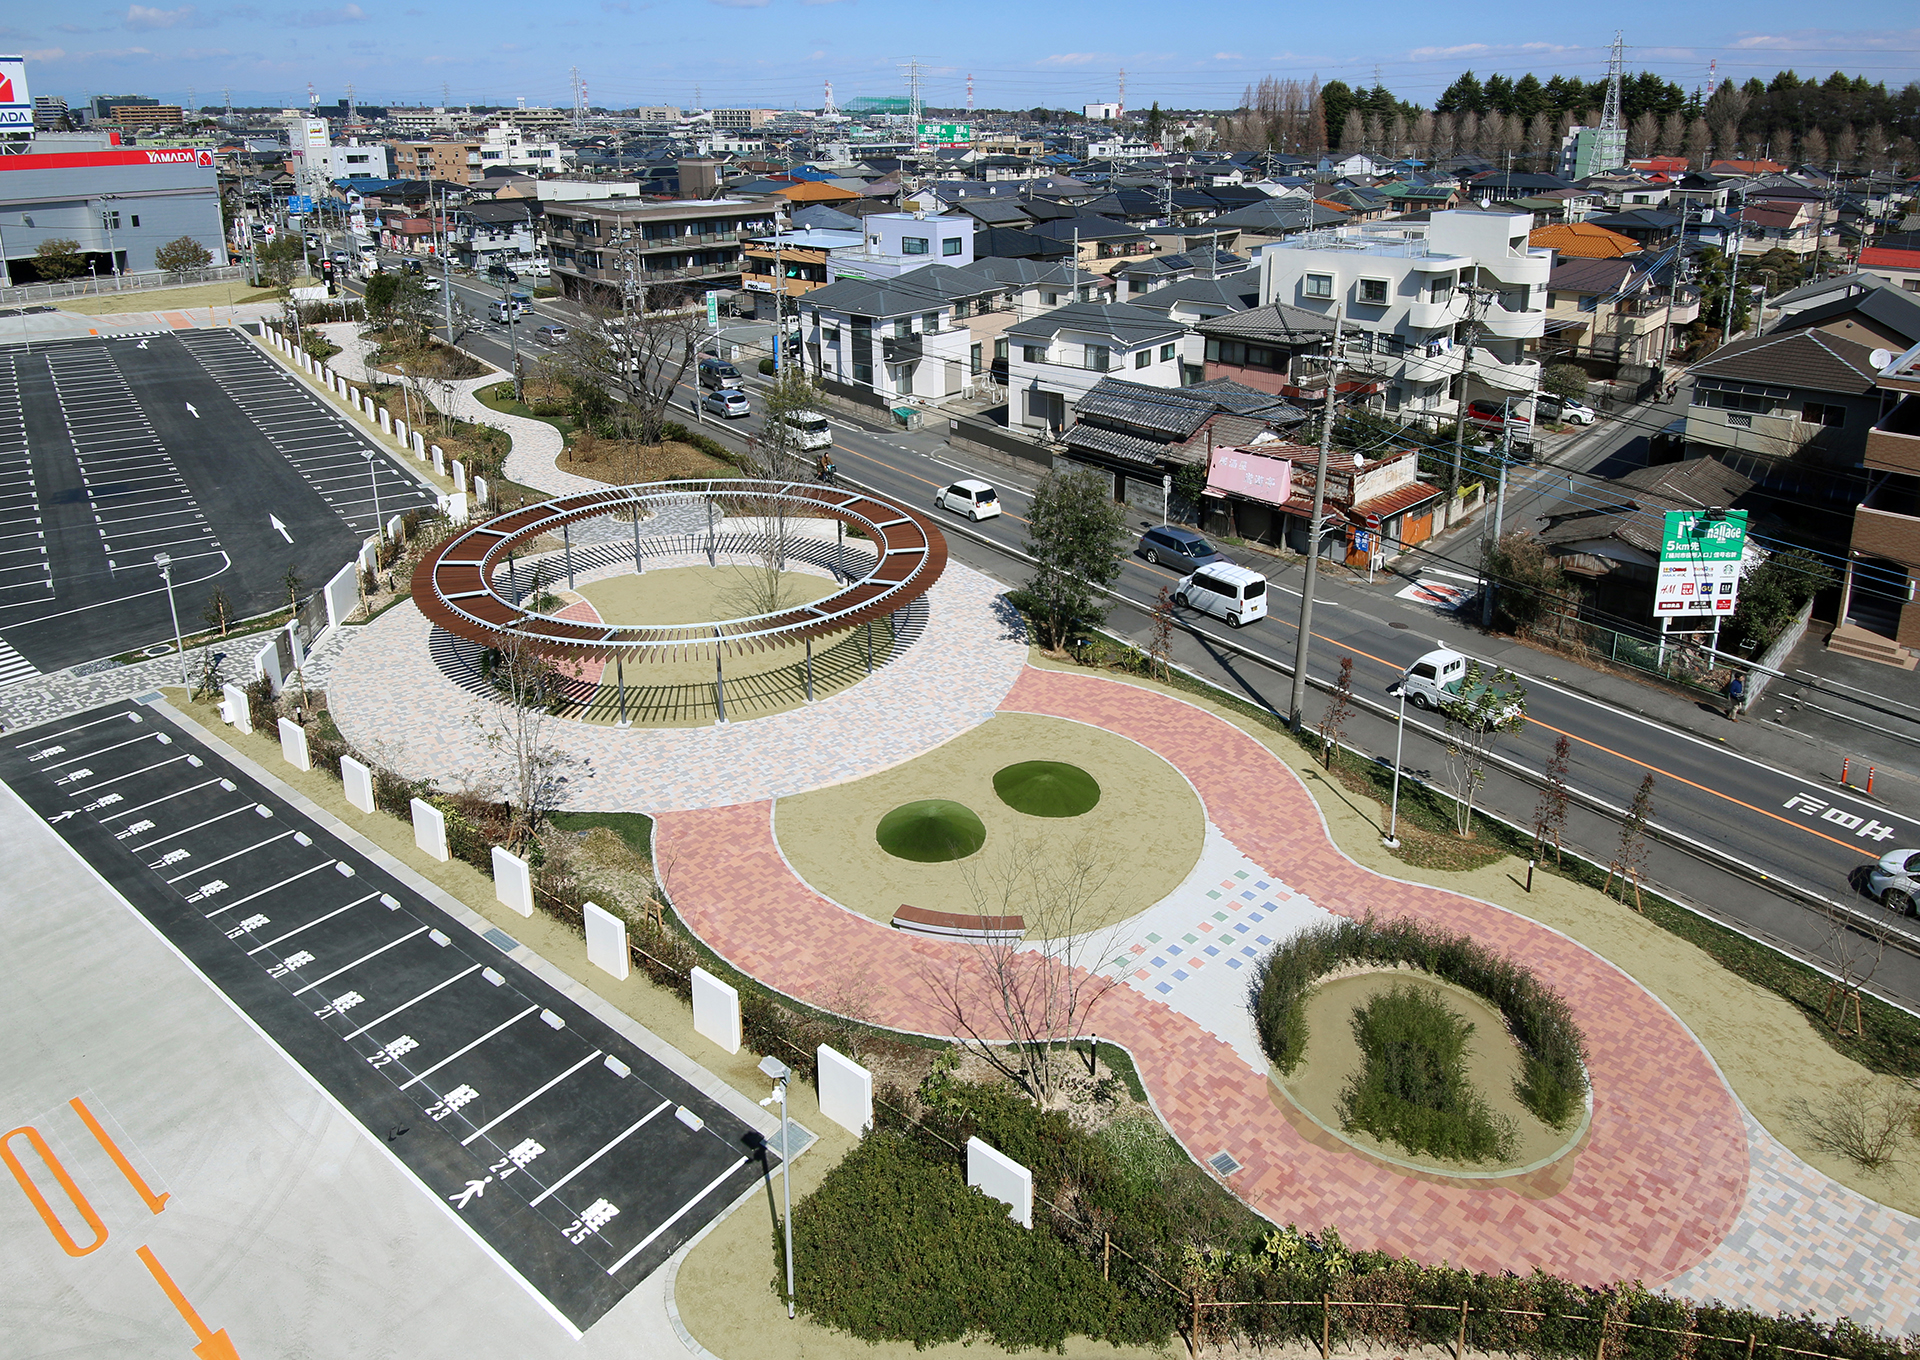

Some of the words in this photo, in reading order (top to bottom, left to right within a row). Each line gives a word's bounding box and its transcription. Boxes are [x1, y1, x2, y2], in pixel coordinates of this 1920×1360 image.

[145, 151, 195, 163] YAMADA
[1218, 456, 1248, 471] 居酒屋
[1666, 540, 1699, 551] 5km先
[265, 963, 290, 979] 20
[313, 1004, 338, 1020] 21
[365, 1050, 393, 1070] 22
[424, 1100, 452, 1122] 23
[0, 1096, 171, 1258] 10
[488, 1156, 519, 1181] 24
[560, 1218, 593, 1246] 25
